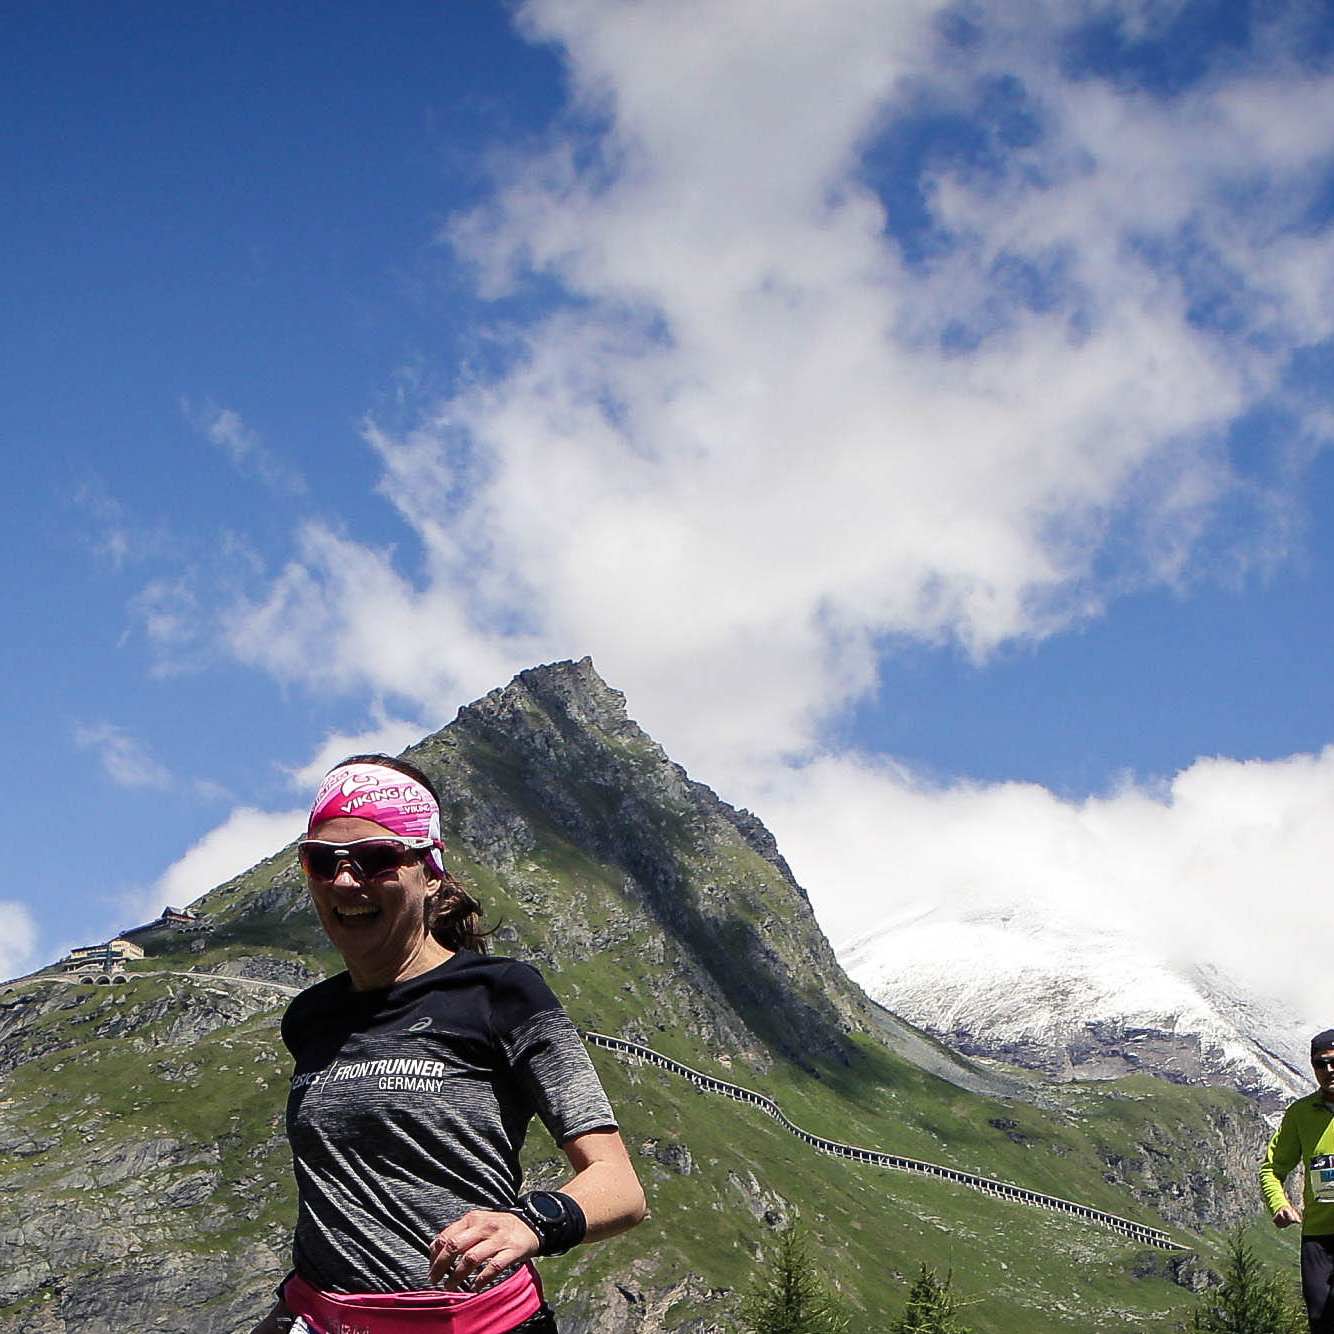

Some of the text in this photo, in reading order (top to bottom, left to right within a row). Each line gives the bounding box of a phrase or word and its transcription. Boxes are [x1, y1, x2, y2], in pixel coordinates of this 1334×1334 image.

[340, 787, 399, 813] VIKING
[403, 803, 431, 814] VIKING
[333, 1058, 445, 1082] FRONTRUNNER
[378, 1076, 444, 1093] GERMANY
